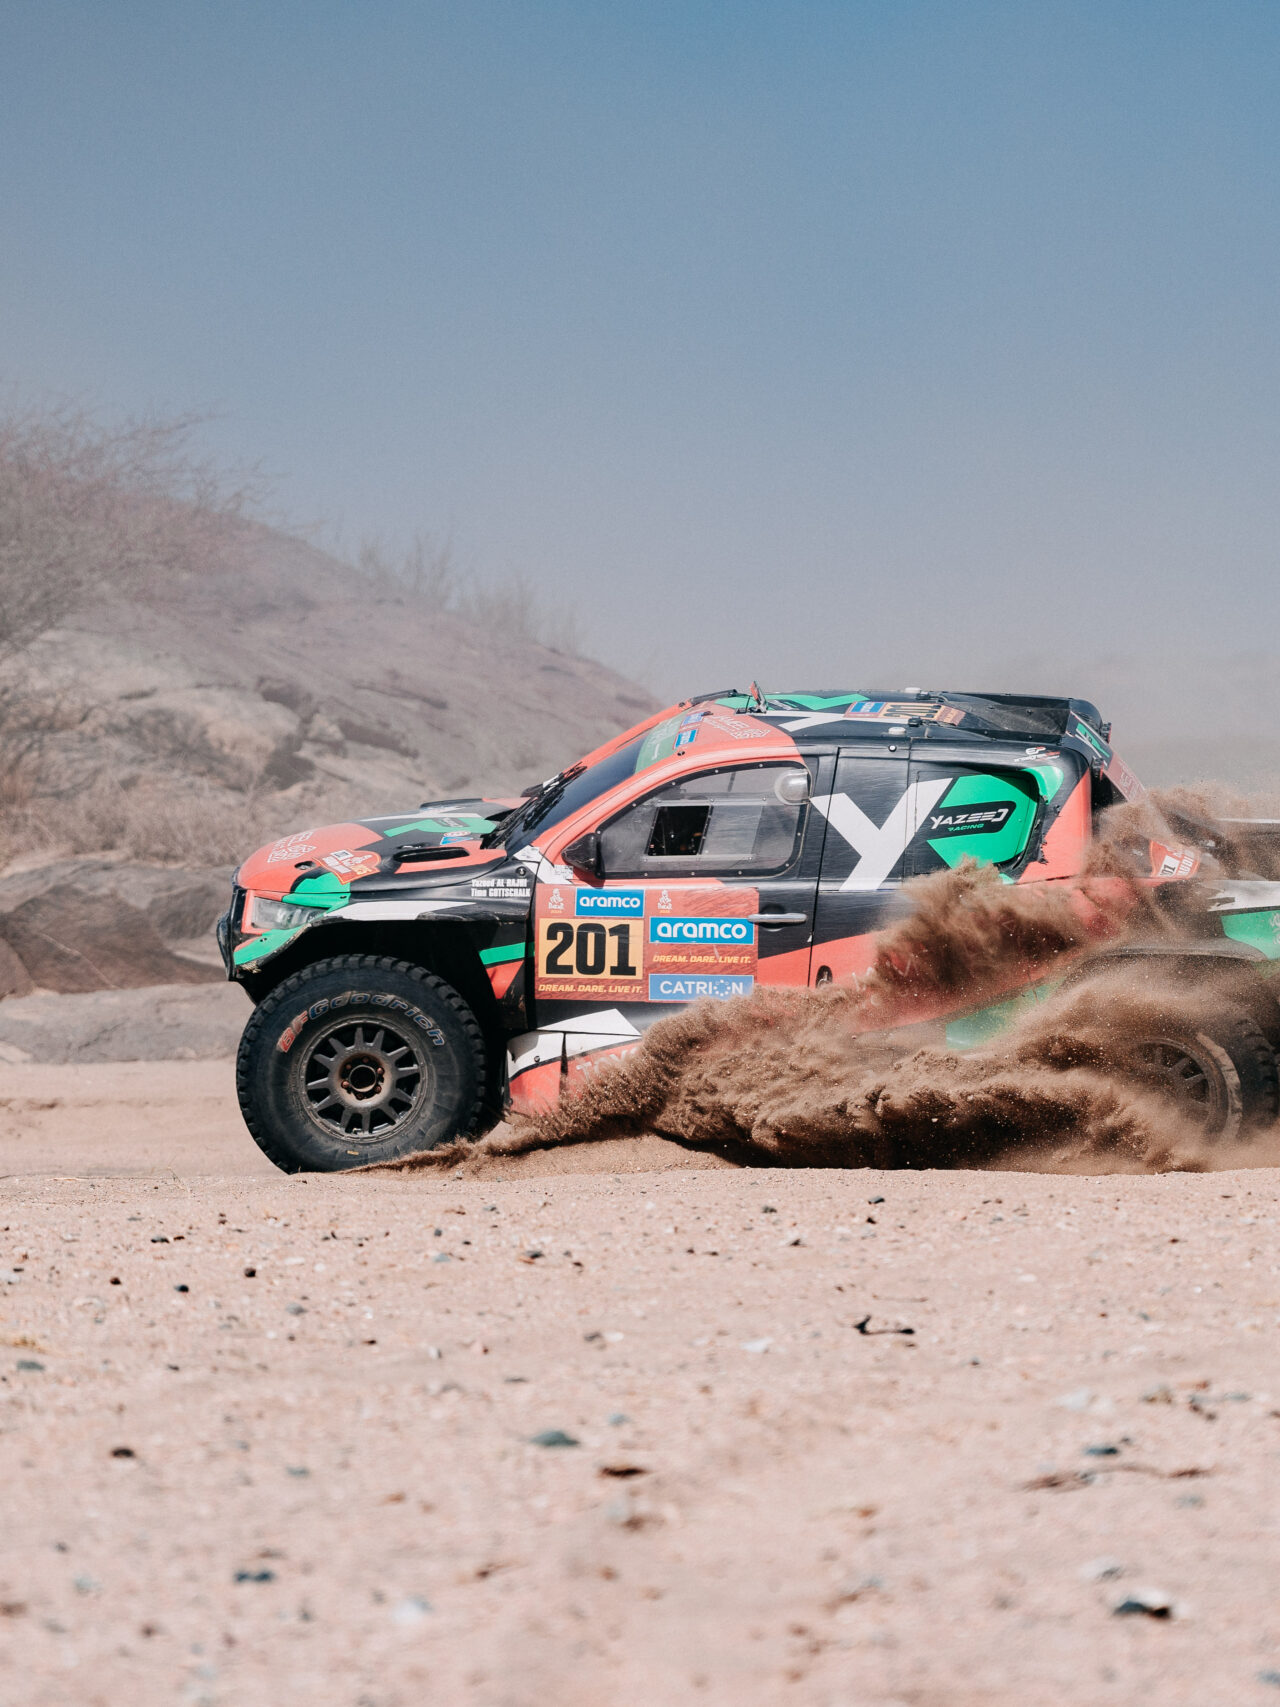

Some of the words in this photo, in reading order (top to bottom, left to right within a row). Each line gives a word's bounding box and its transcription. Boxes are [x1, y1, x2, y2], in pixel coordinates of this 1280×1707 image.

[930, 808, 1009, 830] YAZEED
[471, 888, 488, 898] Timo
[488, 888, 532, 898] GOTTSCHALK
[579, 896, 641, 908] aramco
[656, 922, 748, 939] aramco
[545, 922, 637, 976] 201
[652, 955, 689, 963] DREAM.
[689, 955, 718, 963] DARE.
[740, 956, 752, 964] IT.
[538, 984, 576, 992] DREAM.
[577, 984, 607, 992] DARE.
[608, 985, 631, 993] LIVE
[631, 985, 644, 993] IT.
[660, 979, 744, 997] CATRION
